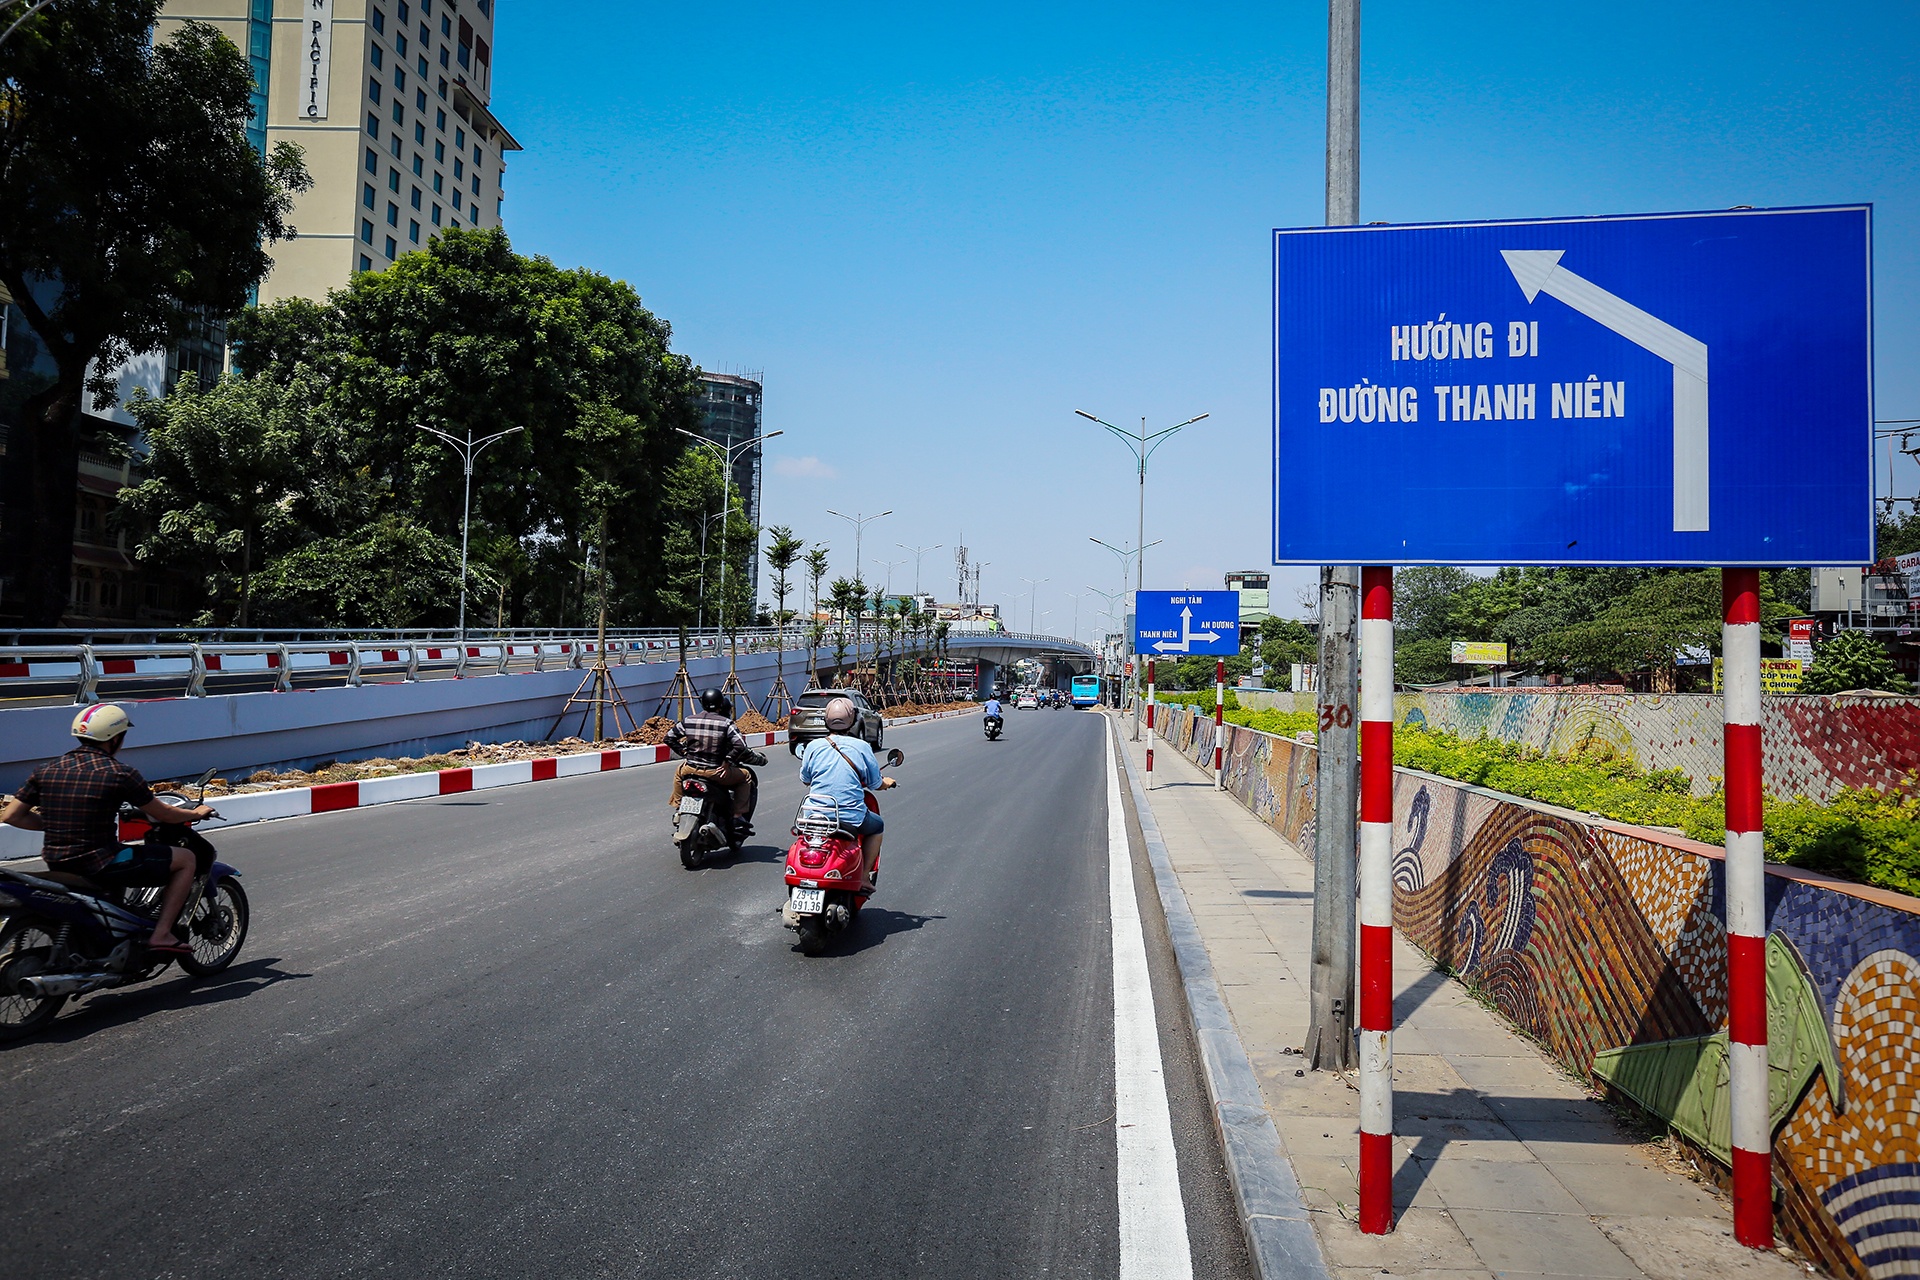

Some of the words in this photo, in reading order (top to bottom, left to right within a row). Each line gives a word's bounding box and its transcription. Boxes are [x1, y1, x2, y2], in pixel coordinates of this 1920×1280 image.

[307, 20, 322, 117] PACIFIC
[1391, 312, 1493, 361] HƯỚNG
[1508, 321, 1539, 358] ĐI
[1318, 377, 1418, 423] ĐƯỜNG
[1434, 383, 1536, 421] THANH
[1551, 374, 1625, 419] NIÊN
[1140, 630, 1161, 638] THANH
[1201, 621, 1210, 629] AN
[792, 900, 821, 912] 691.36
